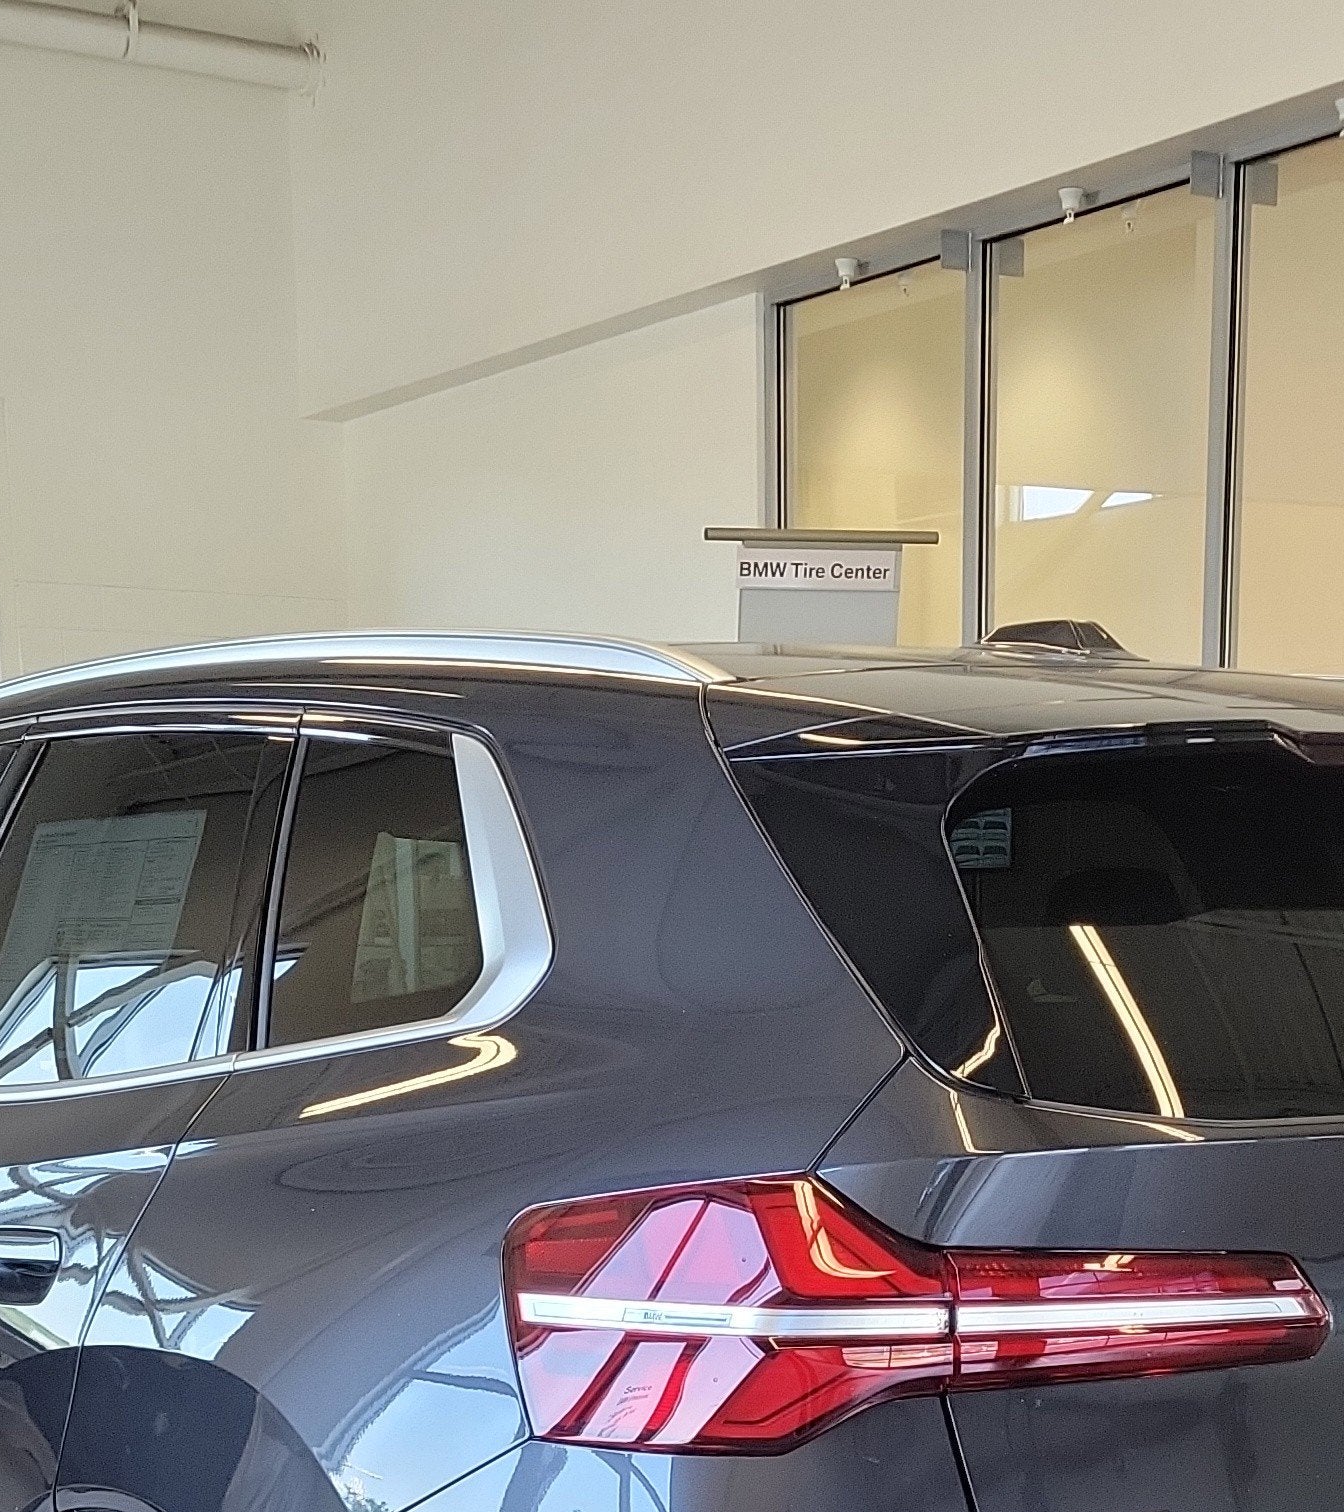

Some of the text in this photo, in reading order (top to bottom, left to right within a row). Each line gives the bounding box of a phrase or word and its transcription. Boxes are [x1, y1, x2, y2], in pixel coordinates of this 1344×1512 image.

[739, 561, 890, 580] BMW Tire Center
